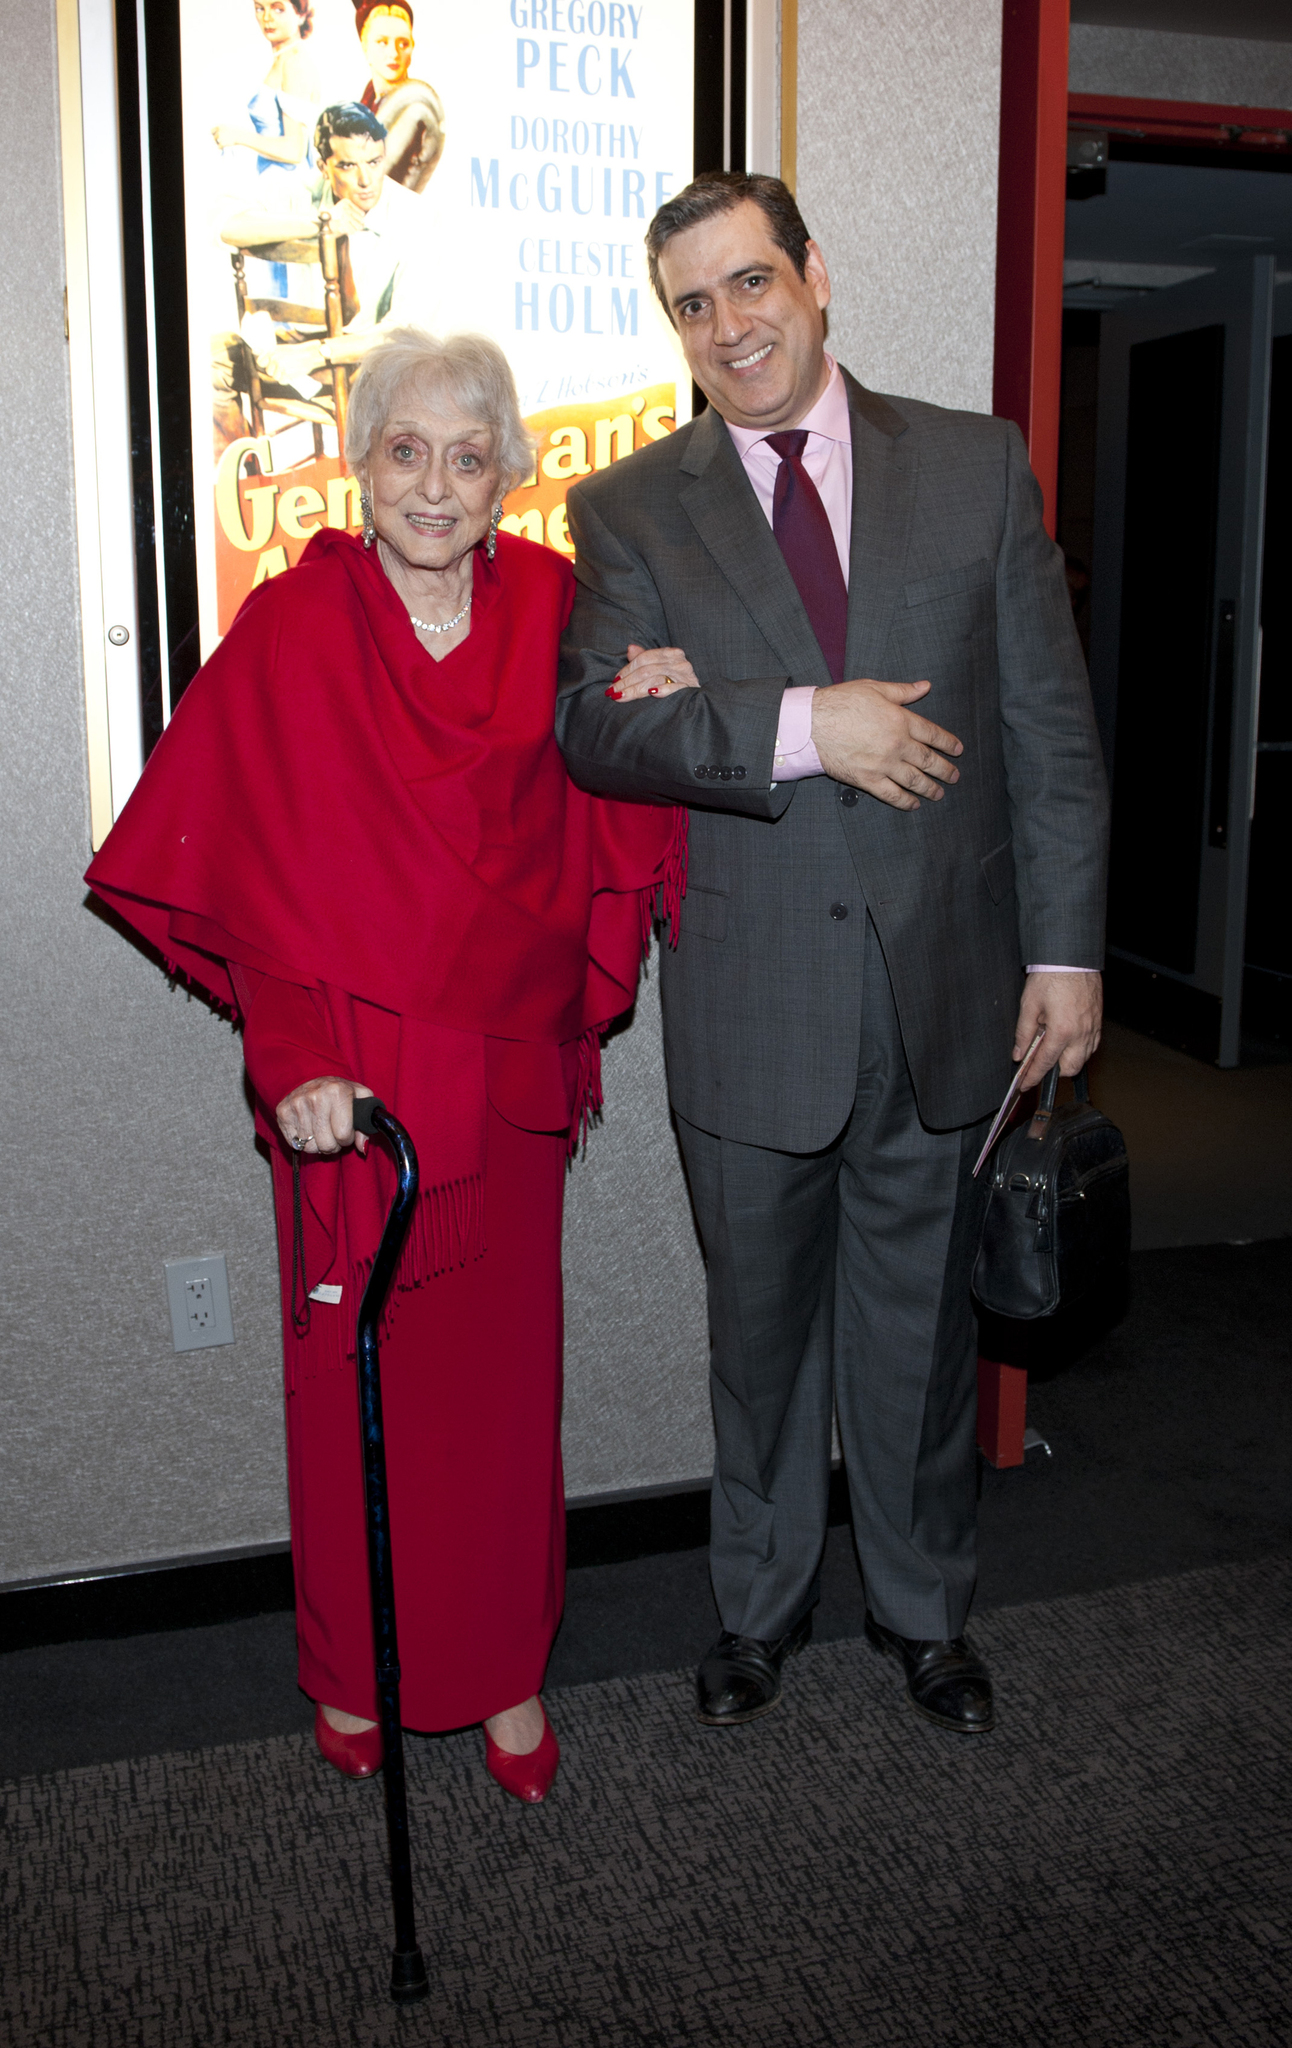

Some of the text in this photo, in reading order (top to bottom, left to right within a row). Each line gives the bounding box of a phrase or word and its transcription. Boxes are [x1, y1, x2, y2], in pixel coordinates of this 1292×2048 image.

[510, 0, 643, 39] GREGORY
[517, 38, 636, 98] PECK
[511, 115, 643, 159] DOROTHY
[519, 237, 635, 278] CELESTE
[515, 281, 638, 336] HOLM
